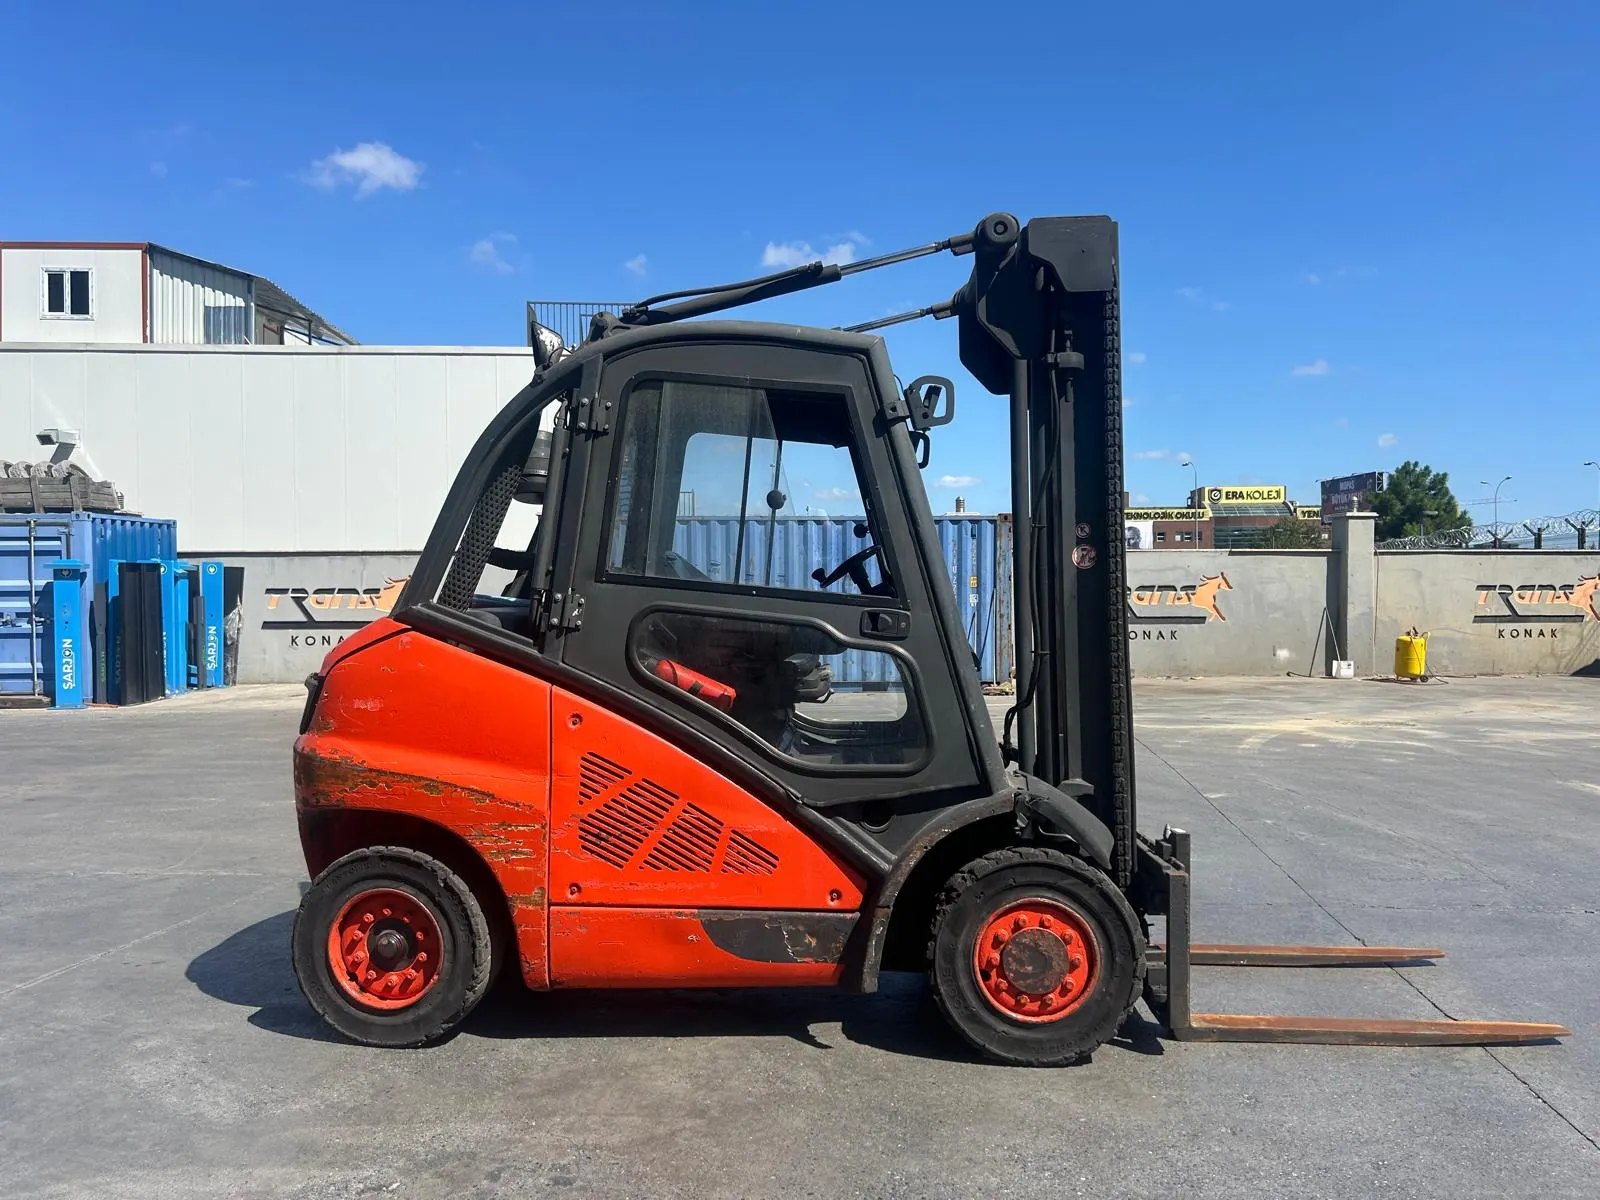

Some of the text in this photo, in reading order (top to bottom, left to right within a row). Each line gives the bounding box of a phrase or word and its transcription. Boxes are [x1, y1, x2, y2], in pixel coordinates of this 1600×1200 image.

[1225, 490, 1245, 500] ERA
[1175, 511, 1204, 520] OKULU
[1301, 510, 1320, 518] YEN
[1129, 630, 1178, 640] ONAK
[1498, 628, 1558, 639] KONAK
[291, 635, 345, 646] KONA
